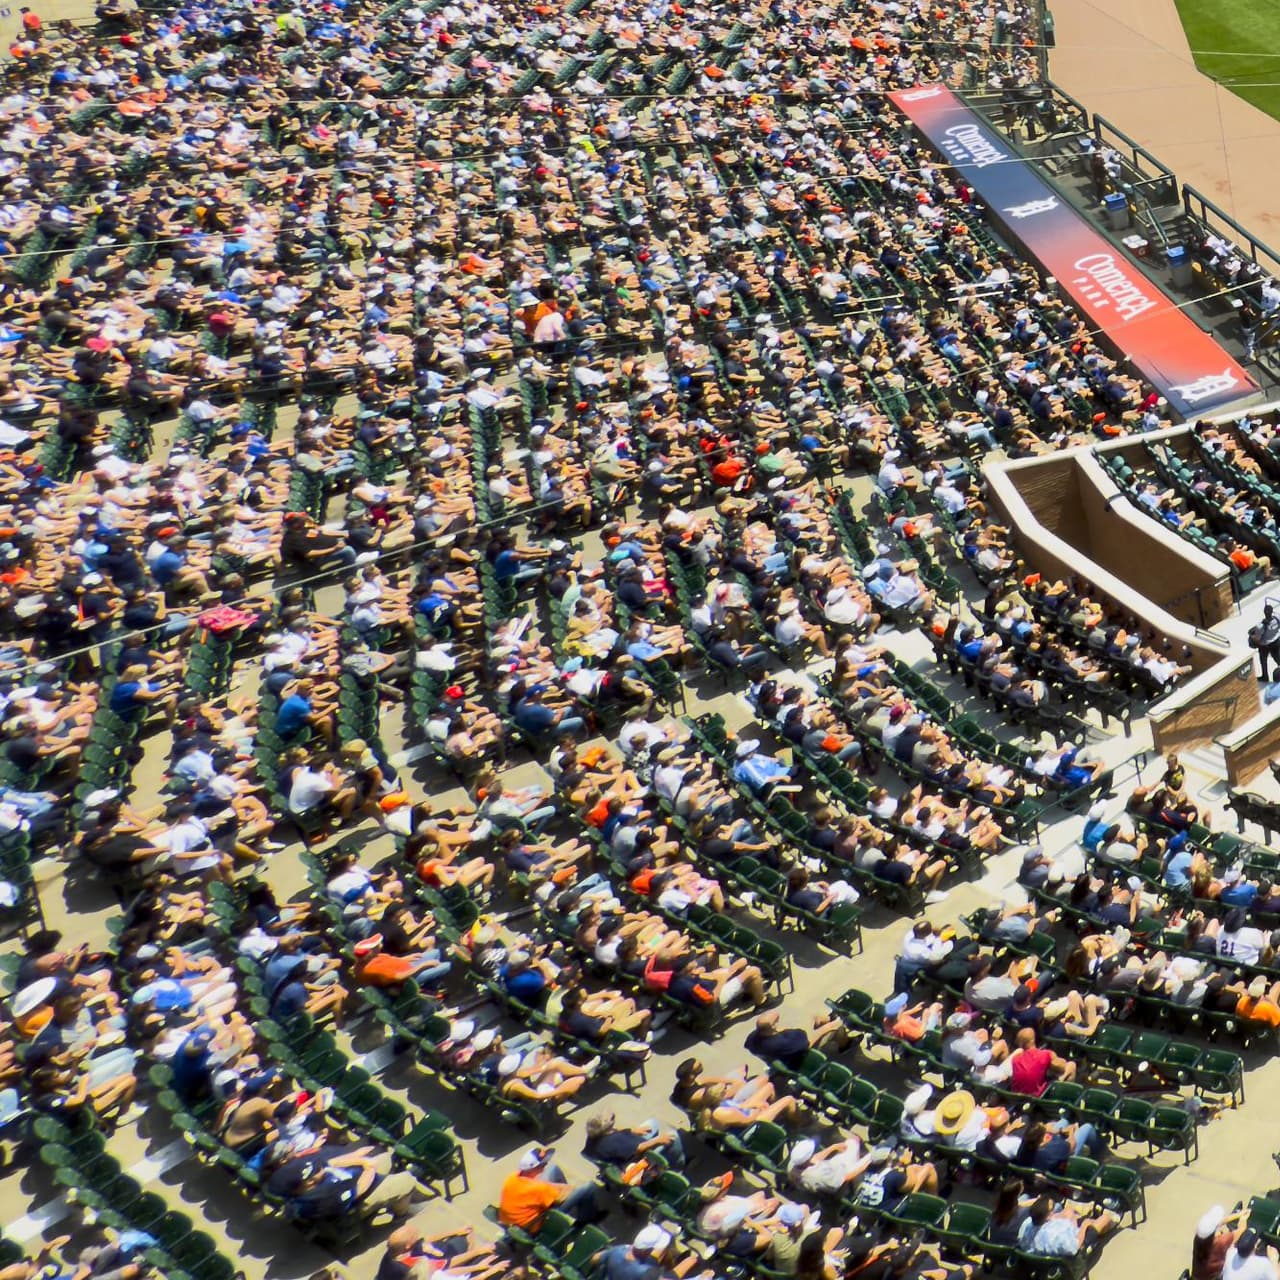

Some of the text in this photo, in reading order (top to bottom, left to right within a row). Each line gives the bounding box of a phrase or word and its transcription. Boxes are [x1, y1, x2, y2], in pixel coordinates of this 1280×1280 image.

[940, 138, 969, 160] PARK
[1072, 276, 1108, 309] PARK
[1221, 940, 1235, 957] 21
